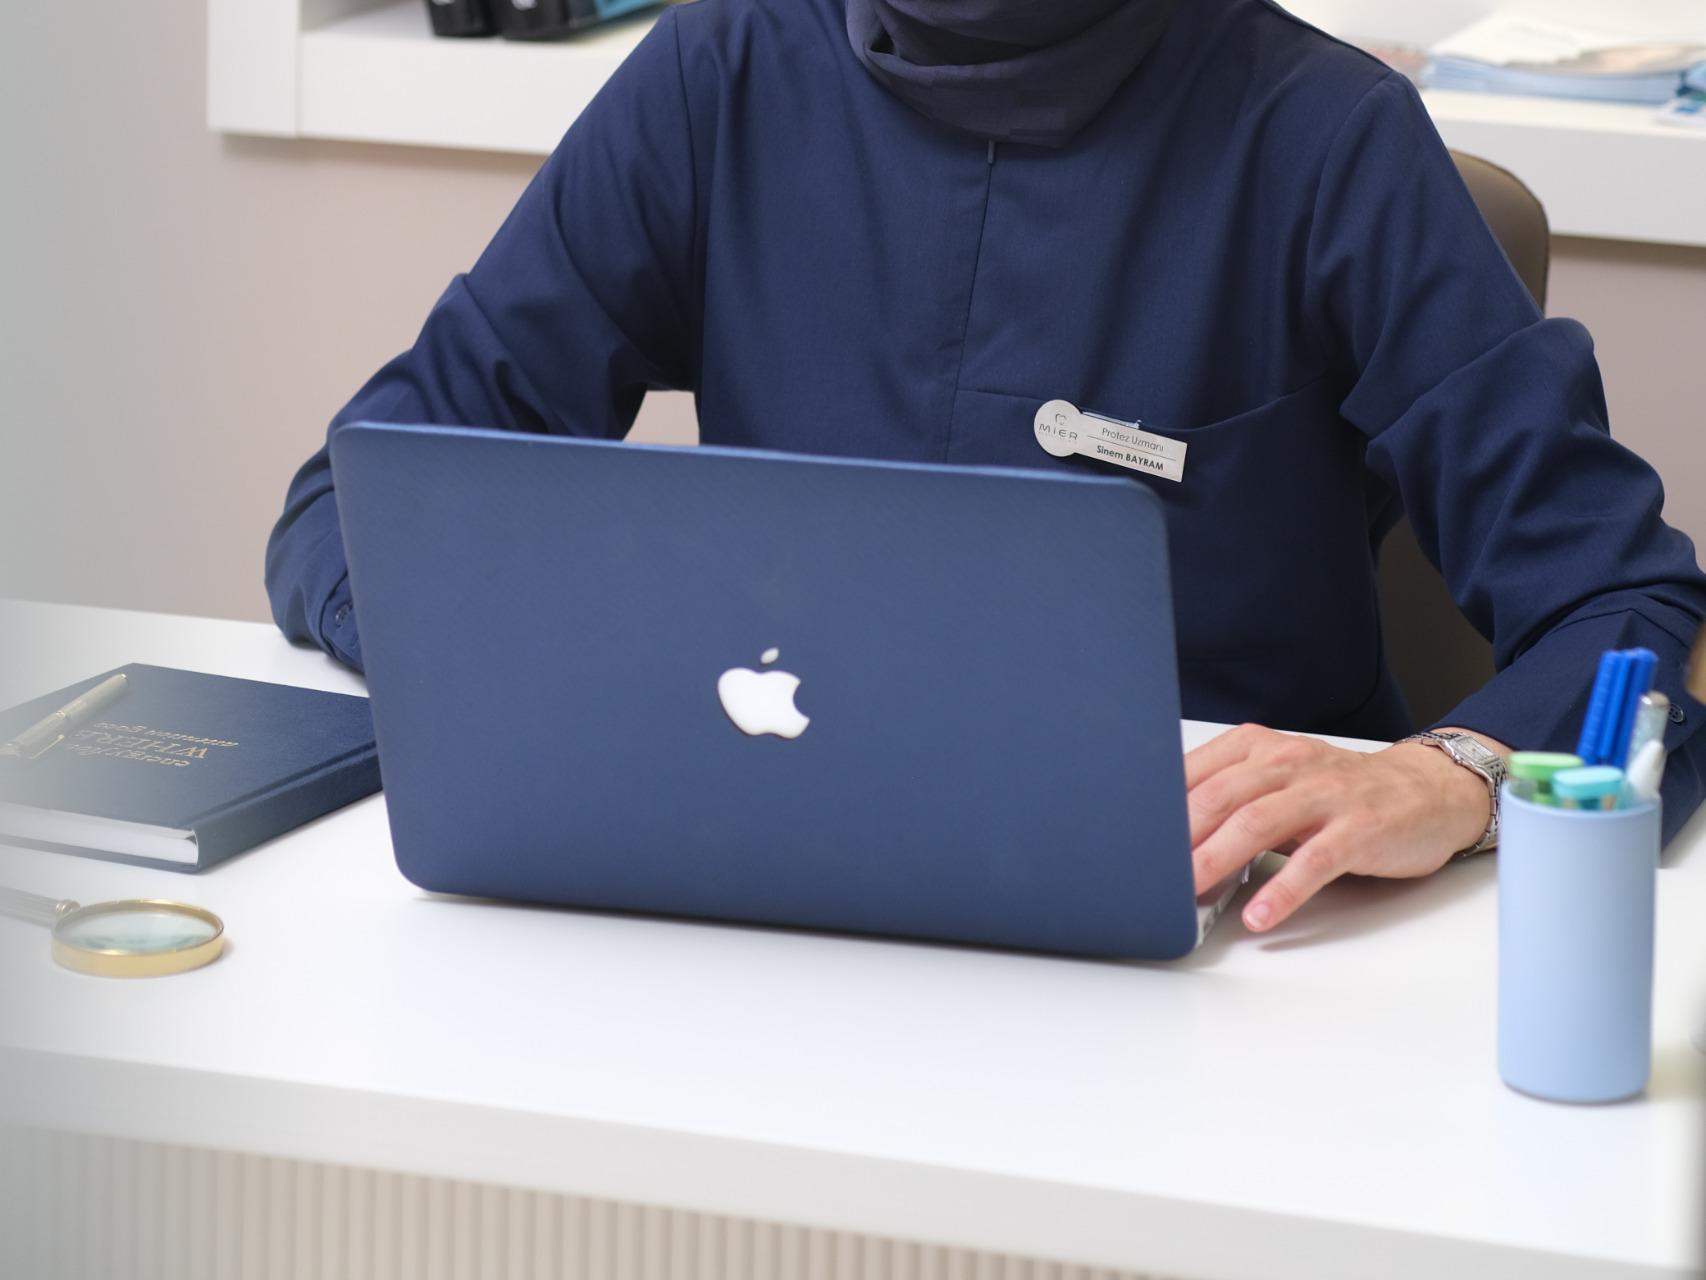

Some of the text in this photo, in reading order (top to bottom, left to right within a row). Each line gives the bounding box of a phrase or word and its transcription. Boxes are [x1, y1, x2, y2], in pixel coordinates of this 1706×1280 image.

[1102, 427, 1129, 443] Protez
[1096, 445, 1164, 471] Sinem BAYRAM
